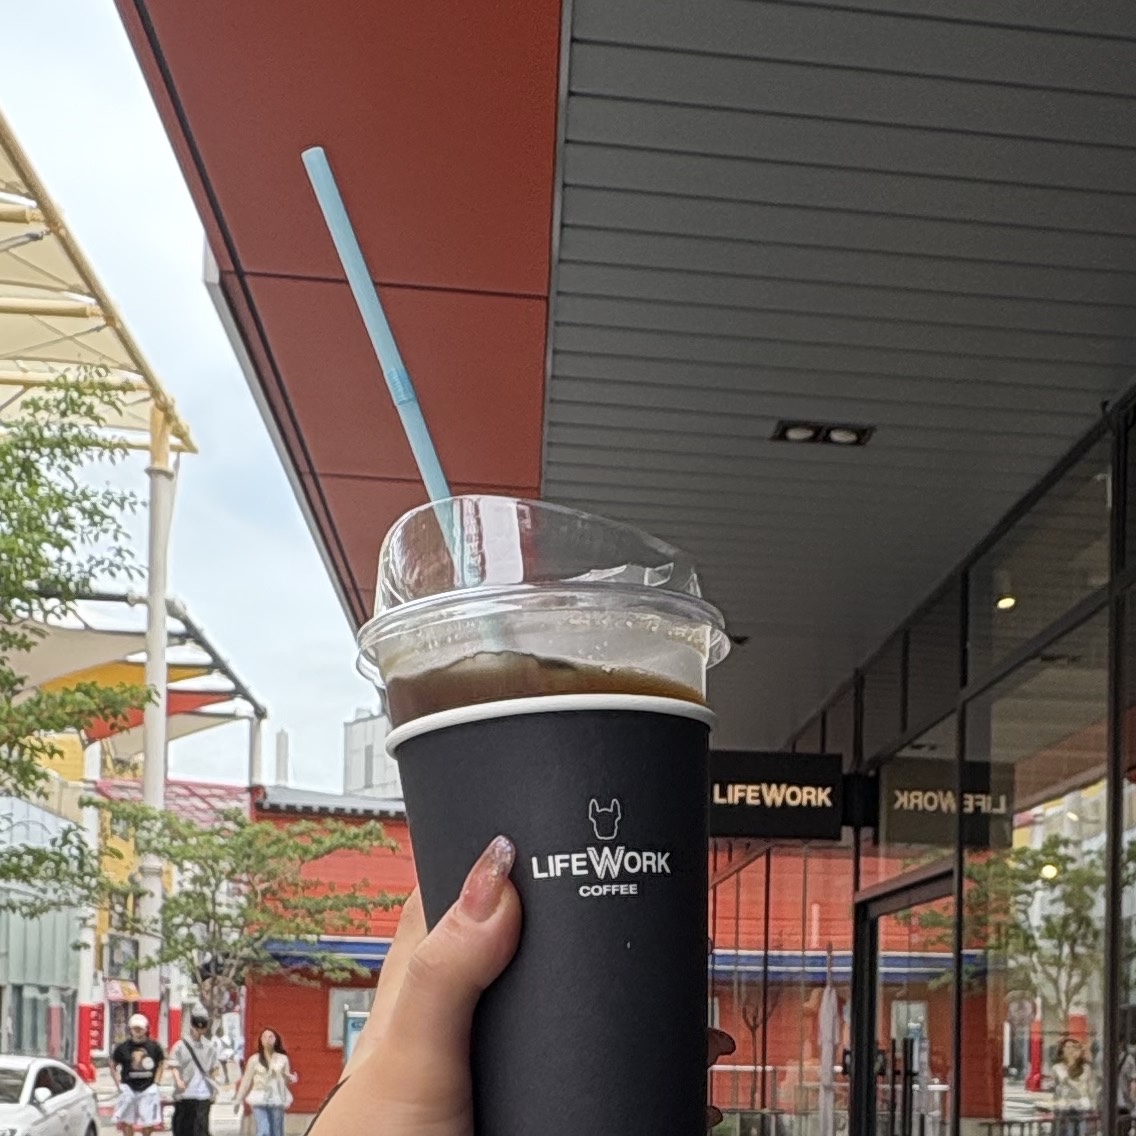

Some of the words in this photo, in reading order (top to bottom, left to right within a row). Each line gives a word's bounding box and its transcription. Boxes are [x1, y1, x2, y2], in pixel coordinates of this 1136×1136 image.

[712, 782, 833, 808] LIFEWORK
[531, 846, 672, 880] LIFEWORK
[578, 884, 639, 897] COFFEE
